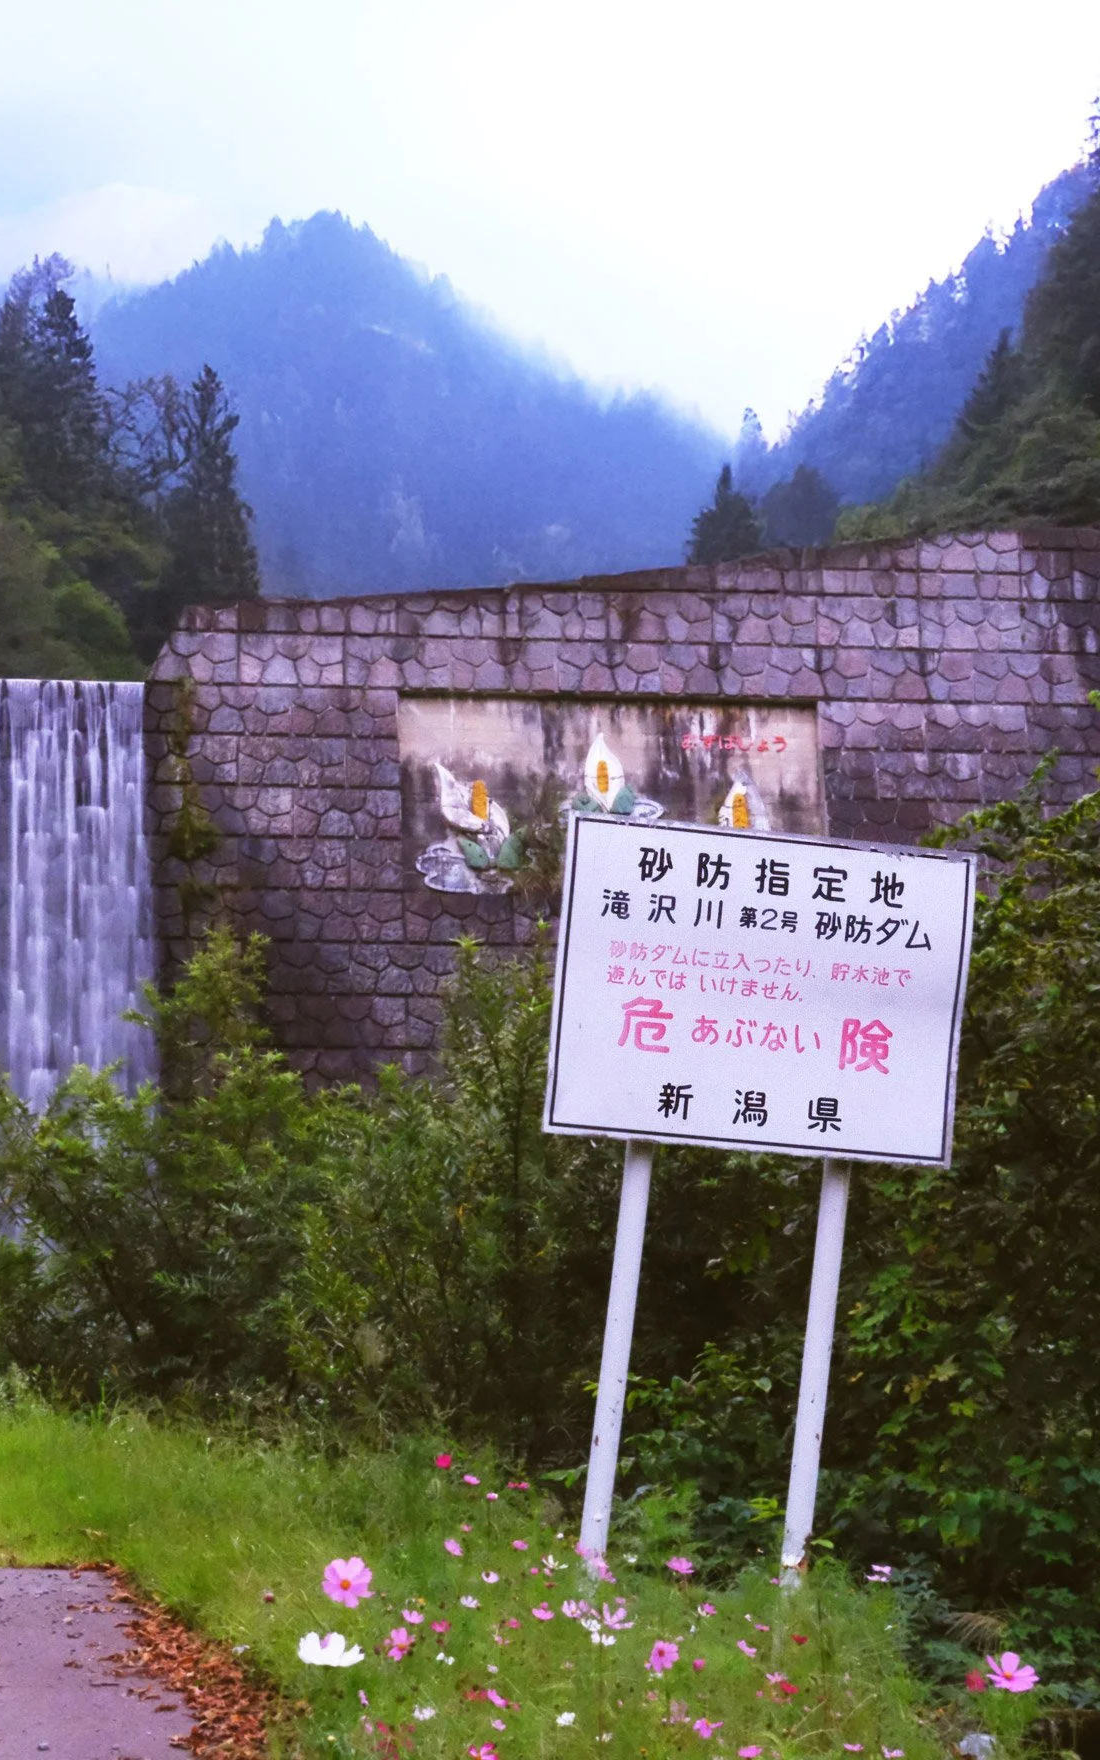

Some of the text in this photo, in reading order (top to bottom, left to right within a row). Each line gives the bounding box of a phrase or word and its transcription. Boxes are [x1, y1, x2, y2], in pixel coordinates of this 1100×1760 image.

[637, 846, 906, 910] 砂防指定地
[600, 888, 932, 952] 滝沢川 第2号 砂防ダム
[617, 996, 894, 1075] 危 あぶない 険
[656, 1081, 843, 1134] 新潟県
